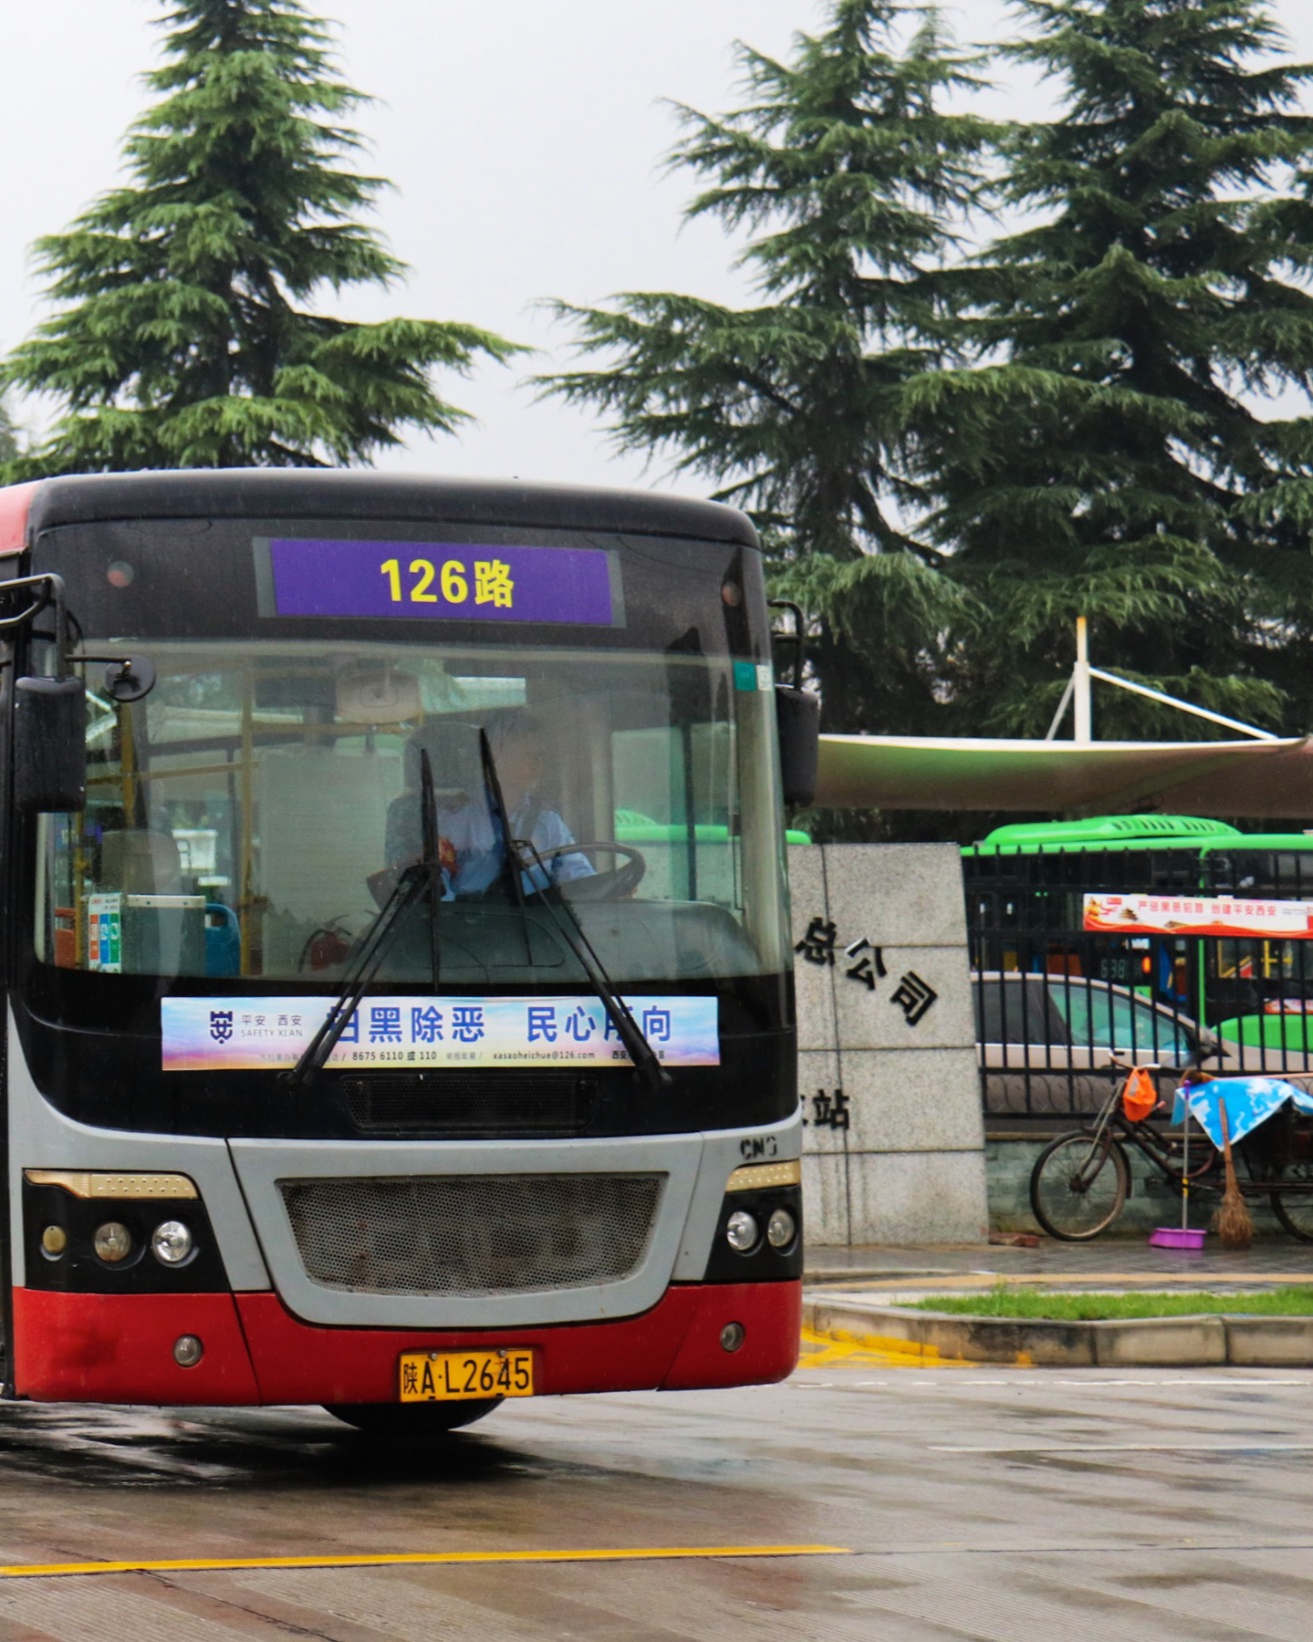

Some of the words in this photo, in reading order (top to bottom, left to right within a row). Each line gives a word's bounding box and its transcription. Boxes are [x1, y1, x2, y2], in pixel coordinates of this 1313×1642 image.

[380, 559, 515, 608] 126路
[795, 917, 938, 1026] 总公司
[241, 1014, 266, 1026] 平安
[277, 1014, 302, 1026] 西安
[241, 1029, 274, 1038] SAFETY
[352, 1051, 376, 1061] 8675
[379, 1051, 404, 1061] 6110
[407, 1051, 416, 1061] 或
[420, 1051, 437, 1060] 110
[800, 1089, 850, 1131] 站
